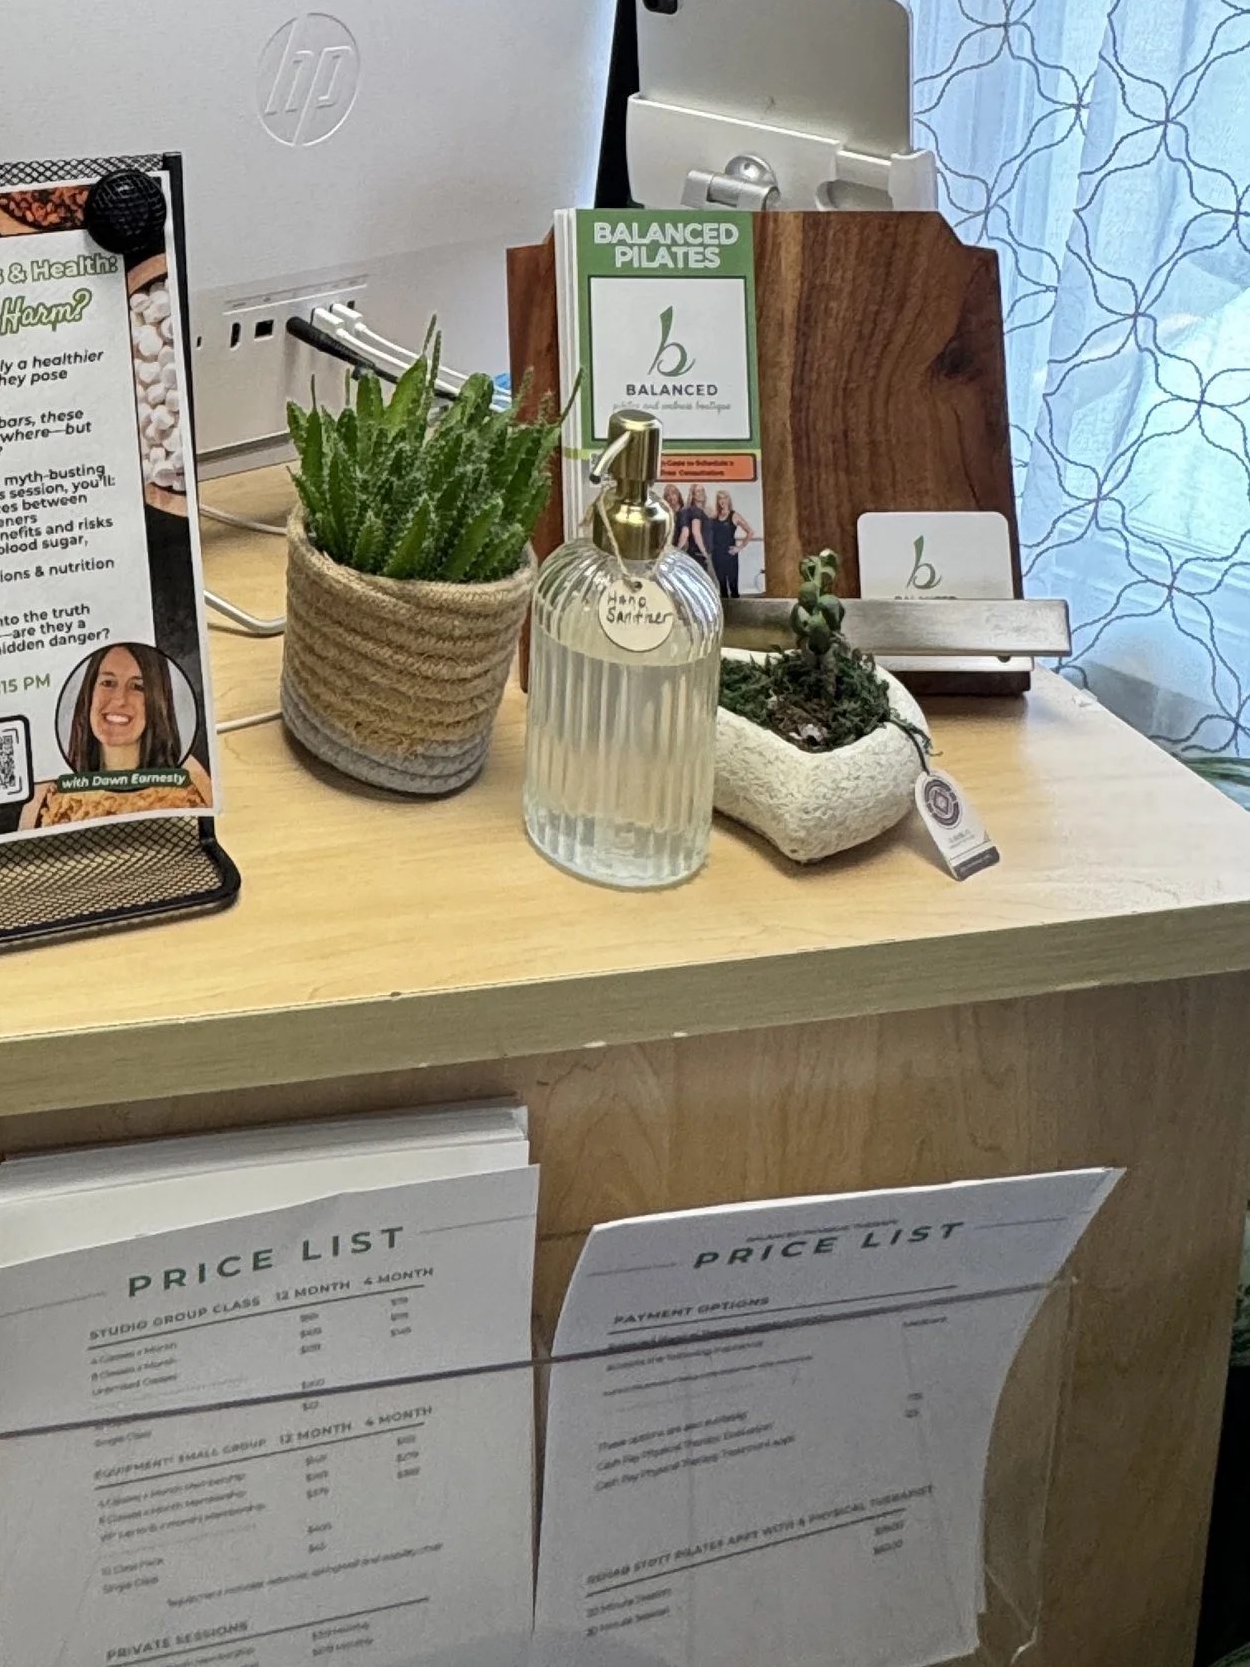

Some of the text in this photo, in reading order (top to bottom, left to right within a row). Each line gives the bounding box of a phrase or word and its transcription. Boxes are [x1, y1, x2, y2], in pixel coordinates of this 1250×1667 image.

[593, 222, 740, 245] BALANCED
[7, 262, 27, 284] &
[30, 252, 119, 282] Health:
[615, 246, 721, 269] PILATES
[16, 359, 28, 371] a
[31, 349, 105, 370] healthier
[626, 384, 719, 396] BALANCED
[39, 409, 85, 424] these
[3, 463, 107, 488] myth-busting
[21, 490, 88, 512] between
[45, 519, 75, 536] and
[77, 515, 114, 531] risks
[41, 534, 89, 551] sugar,
[34, 564, 46, 578] &
[48, 556, 115, 577] nutrition
[22, 610, 49, 624] the
[51, 602, 91, 620] truth
[48, 627, 111, 648] danger?
[23, 672, 51, 691] PM
[61, 771, 187, 790] with Dawn Earnesty
[692, 1235, 840, 1270] PRICE
[859, 1222, 965, 1251] LIST
[128, 1227, 404, 1298] PRICE LIST
[377, 1267, 435, 1285] MONTH
[275, 1280, 350, 1302] 12 MONTH
[89, 1295, 261, 1341] STUDIO GROUP CLASS
[612, 1296, 770, 1325] PAYMENT OPTIONS
